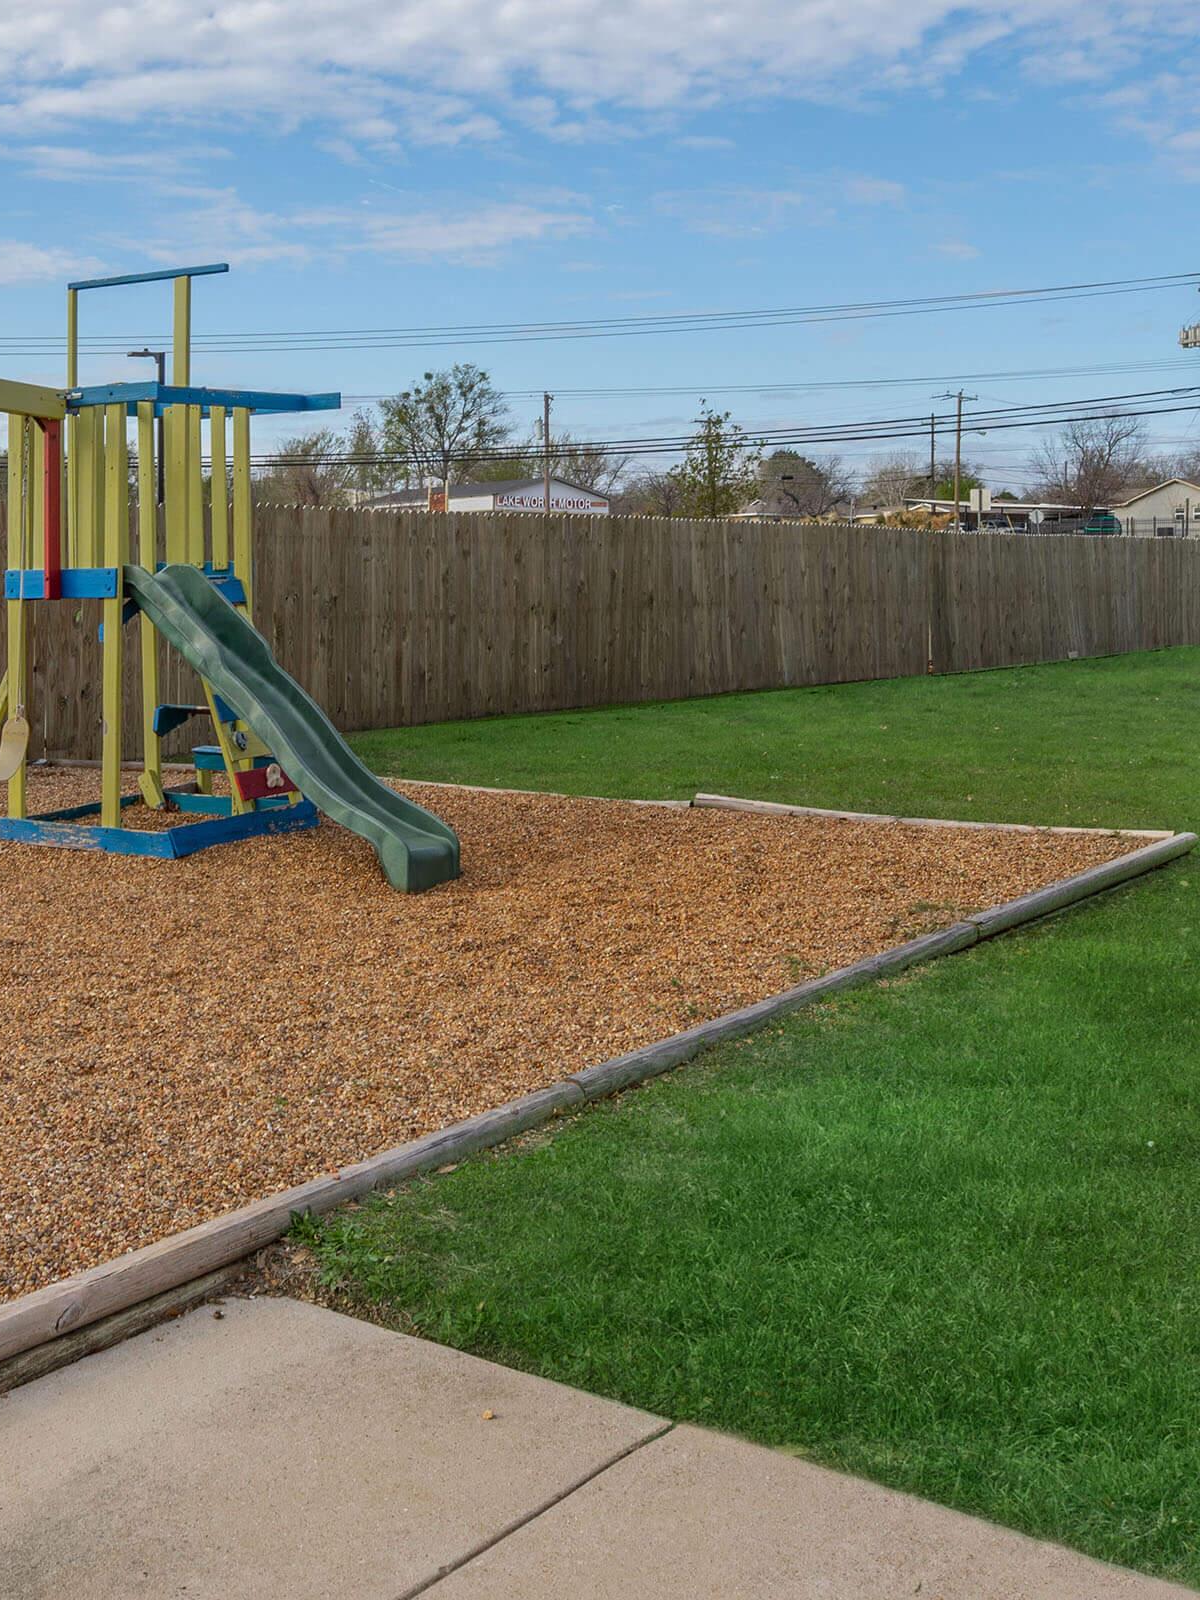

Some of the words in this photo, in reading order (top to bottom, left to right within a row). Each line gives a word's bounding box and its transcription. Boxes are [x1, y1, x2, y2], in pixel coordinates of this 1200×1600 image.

[496, 495, 520, 506] LAKE
[523, 496, 555, 509] WORH
[559, 498, 591, 509] MOTOR
